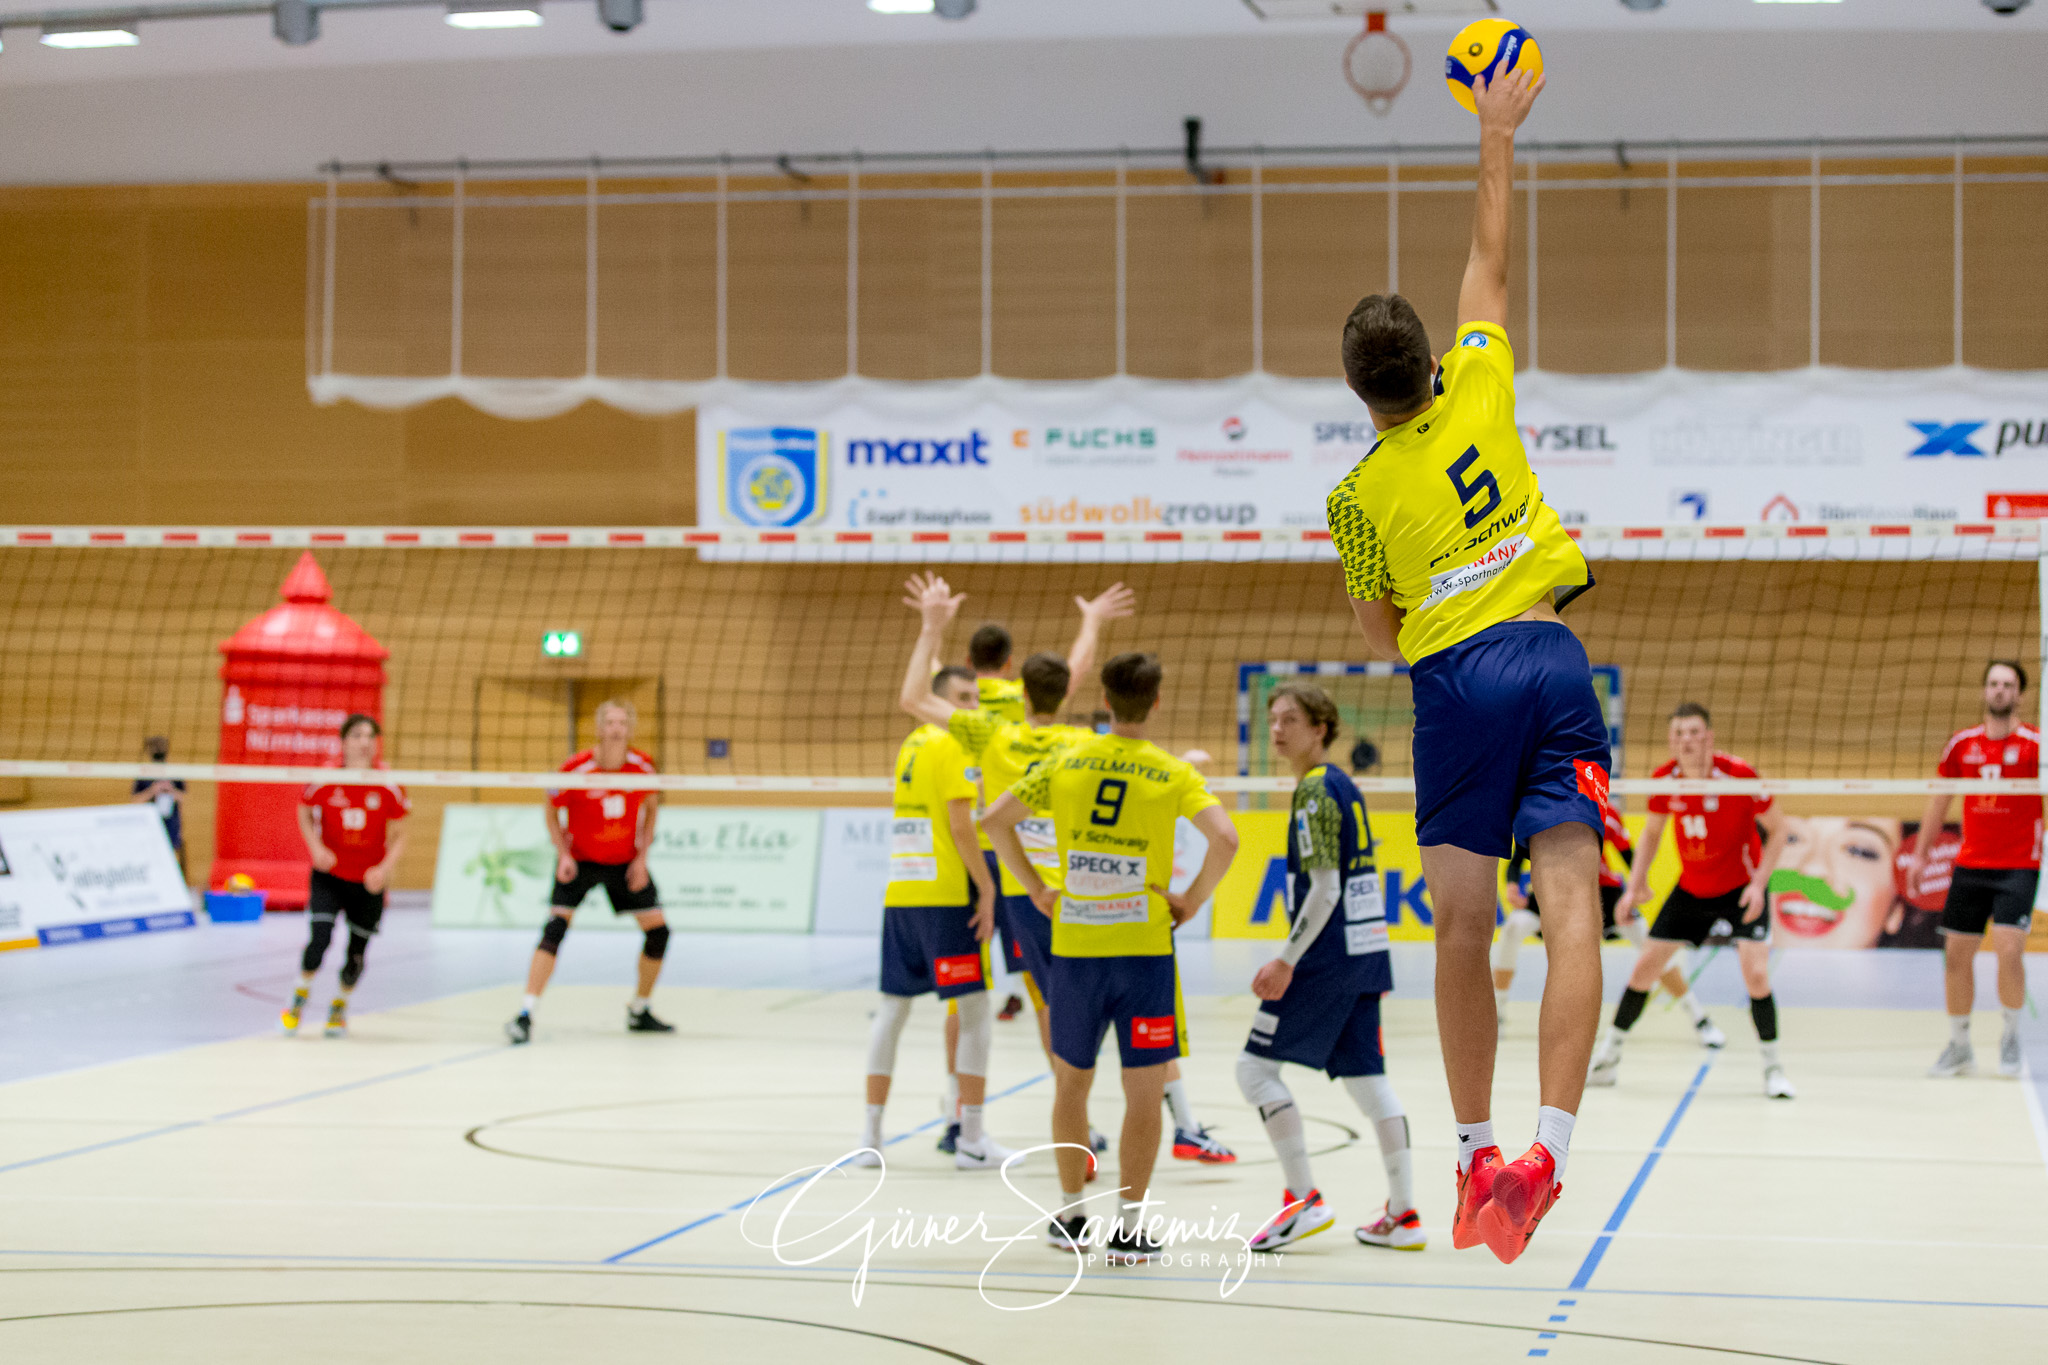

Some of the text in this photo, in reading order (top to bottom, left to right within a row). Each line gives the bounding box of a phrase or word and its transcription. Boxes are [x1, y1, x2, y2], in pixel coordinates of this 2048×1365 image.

[847, 430, 989, 466] maxit
[1445, 443, 1502, 530] 5
[1090, 777, 1129, 828] 9
